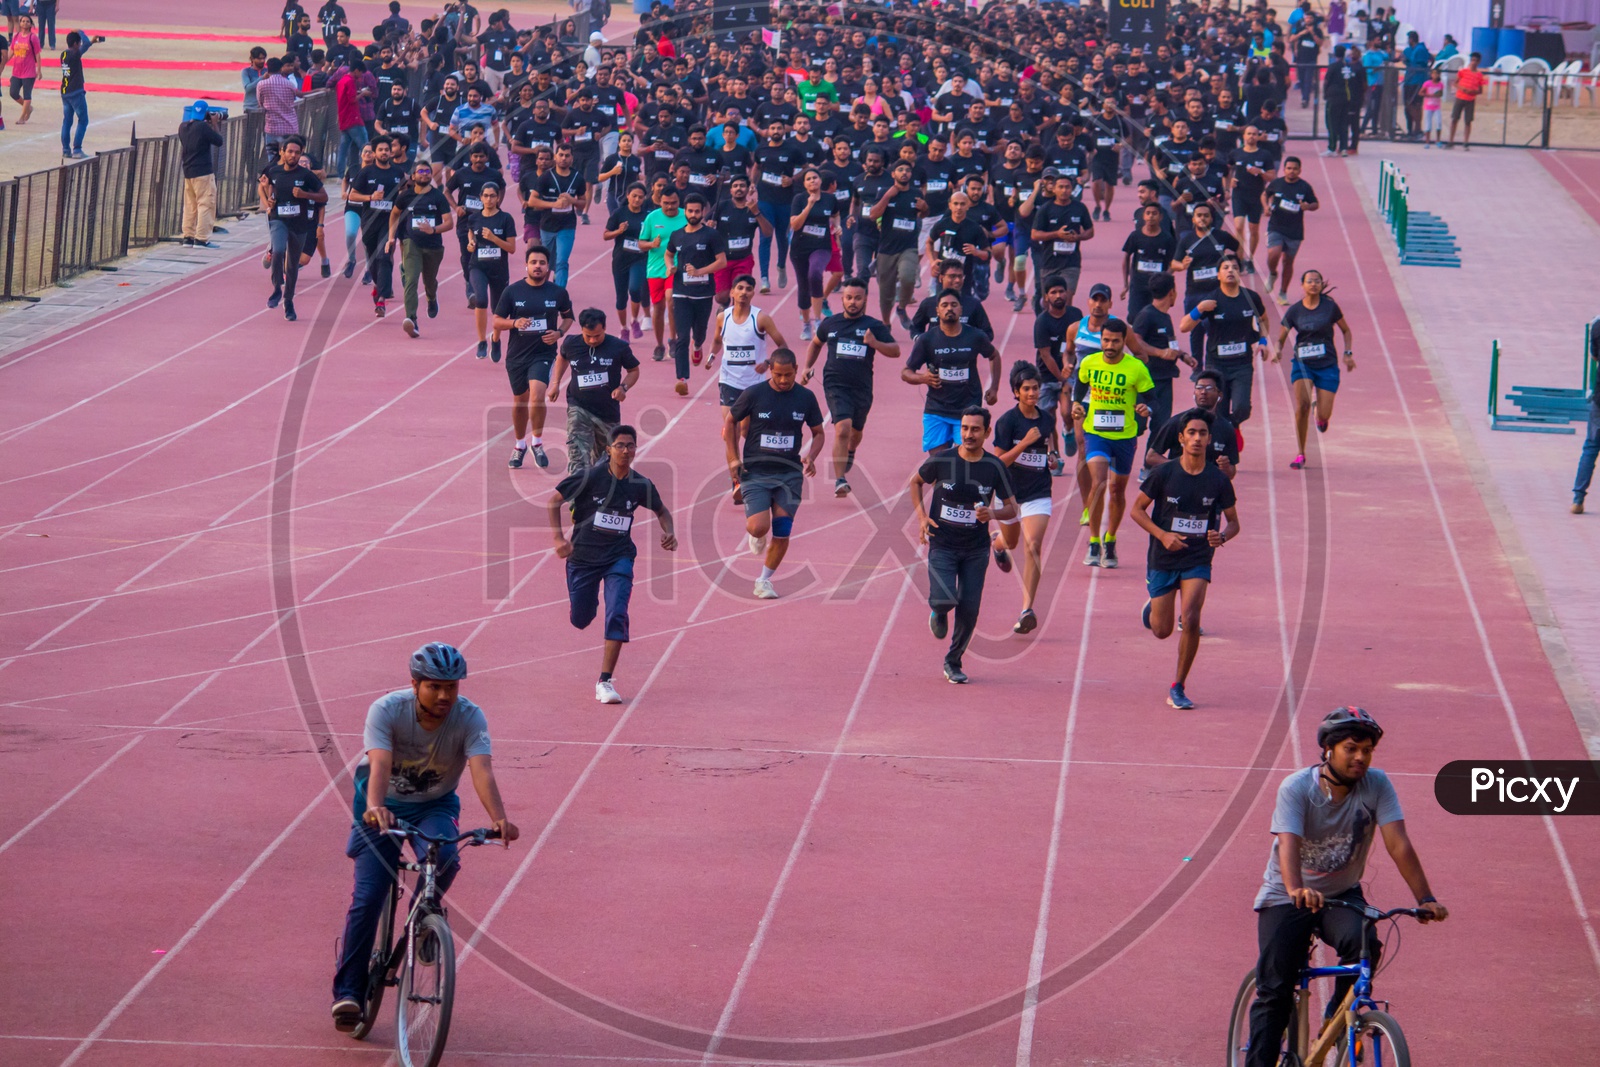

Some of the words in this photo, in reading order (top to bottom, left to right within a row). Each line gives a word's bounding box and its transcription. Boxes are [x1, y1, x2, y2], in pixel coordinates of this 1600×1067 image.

[841, 344, 862, 353] 5547
[1222, 344, 1242, 352] 5469
[1301, 345, 1321, 354] 5544
[583, 374, 603, 383] 5513
[1113, 387, 1127, 396] OF
[1100, 415, 1116, 423] 5111
[766, 437, 789, 445] 5636
[1021, 453, 1042, 463] 5393
[946, 507, 971, 519] 5592
[601, 515, 625, 525] 5301
[1177, 519, 1203, 529] 5458
